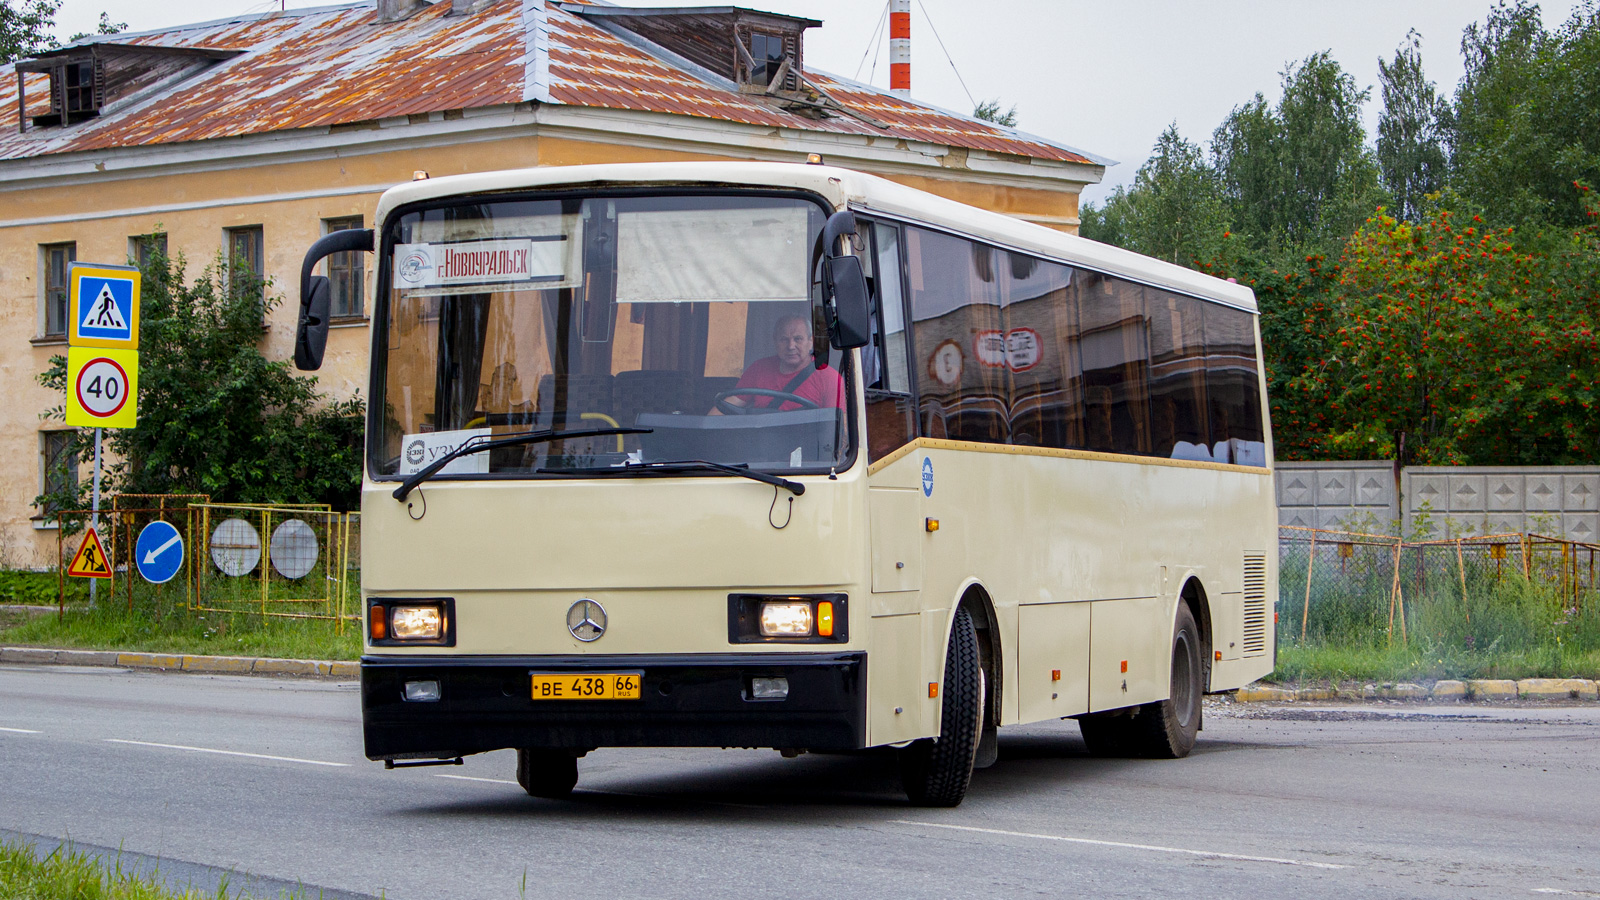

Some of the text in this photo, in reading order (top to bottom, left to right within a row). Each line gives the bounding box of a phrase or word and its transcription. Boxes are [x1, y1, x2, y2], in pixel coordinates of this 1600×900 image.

[86, 375, 119, 400] 40
[541, 676, 633, 696] ВЕ 438 66
